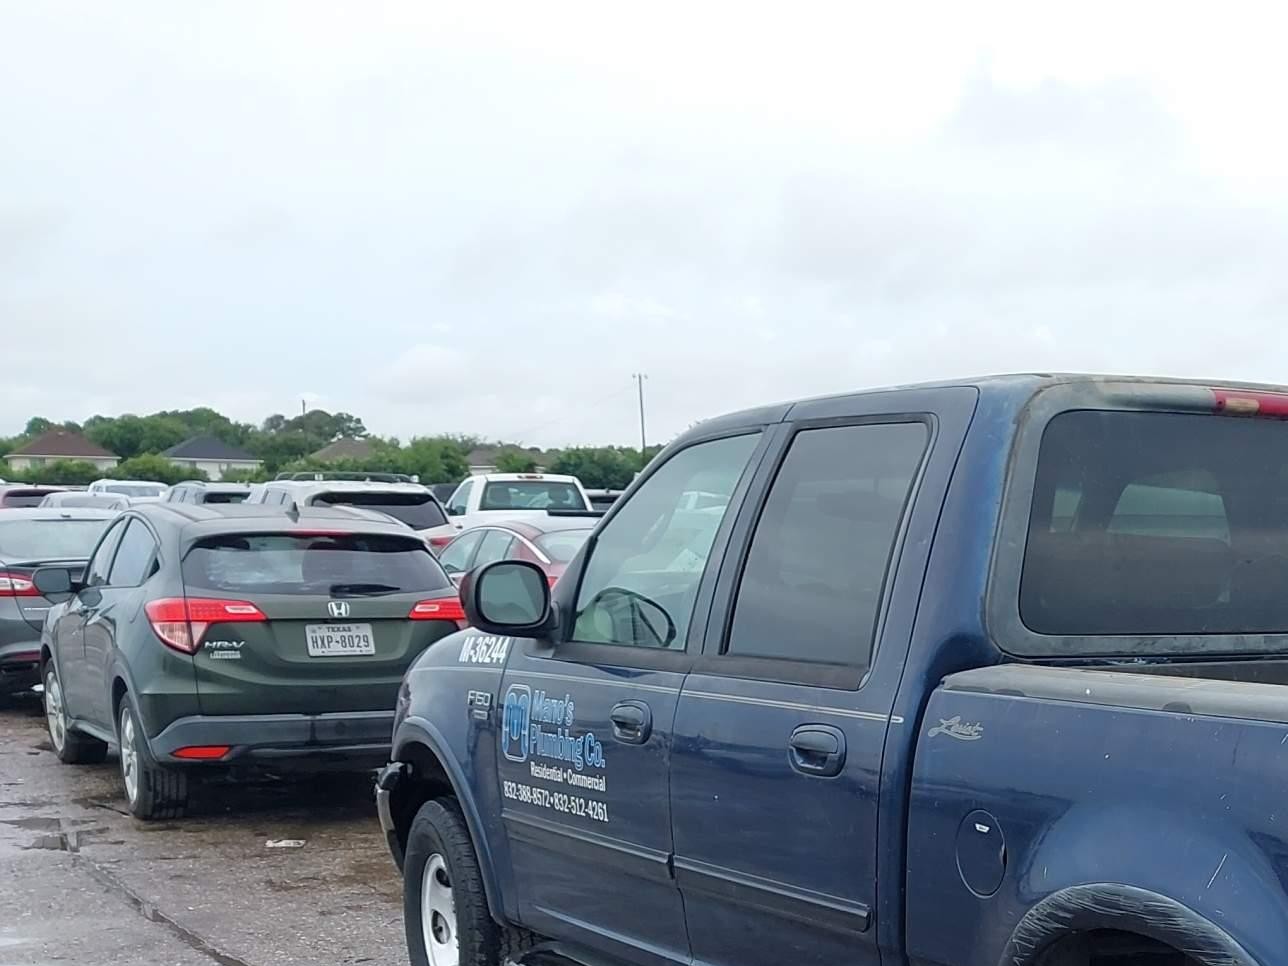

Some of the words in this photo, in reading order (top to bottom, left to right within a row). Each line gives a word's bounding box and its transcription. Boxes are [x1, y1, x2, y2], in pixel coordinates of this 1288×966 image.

[458, 636, 510, 664] M-36244
[531, 689, 575, 727] Mano's
[529, 723, 584, 771] Plumbing
[584, 732, 606, 768] Co.
[530, 761, 563, 782] Residential
[567, 769, 606, 792] Commercial
